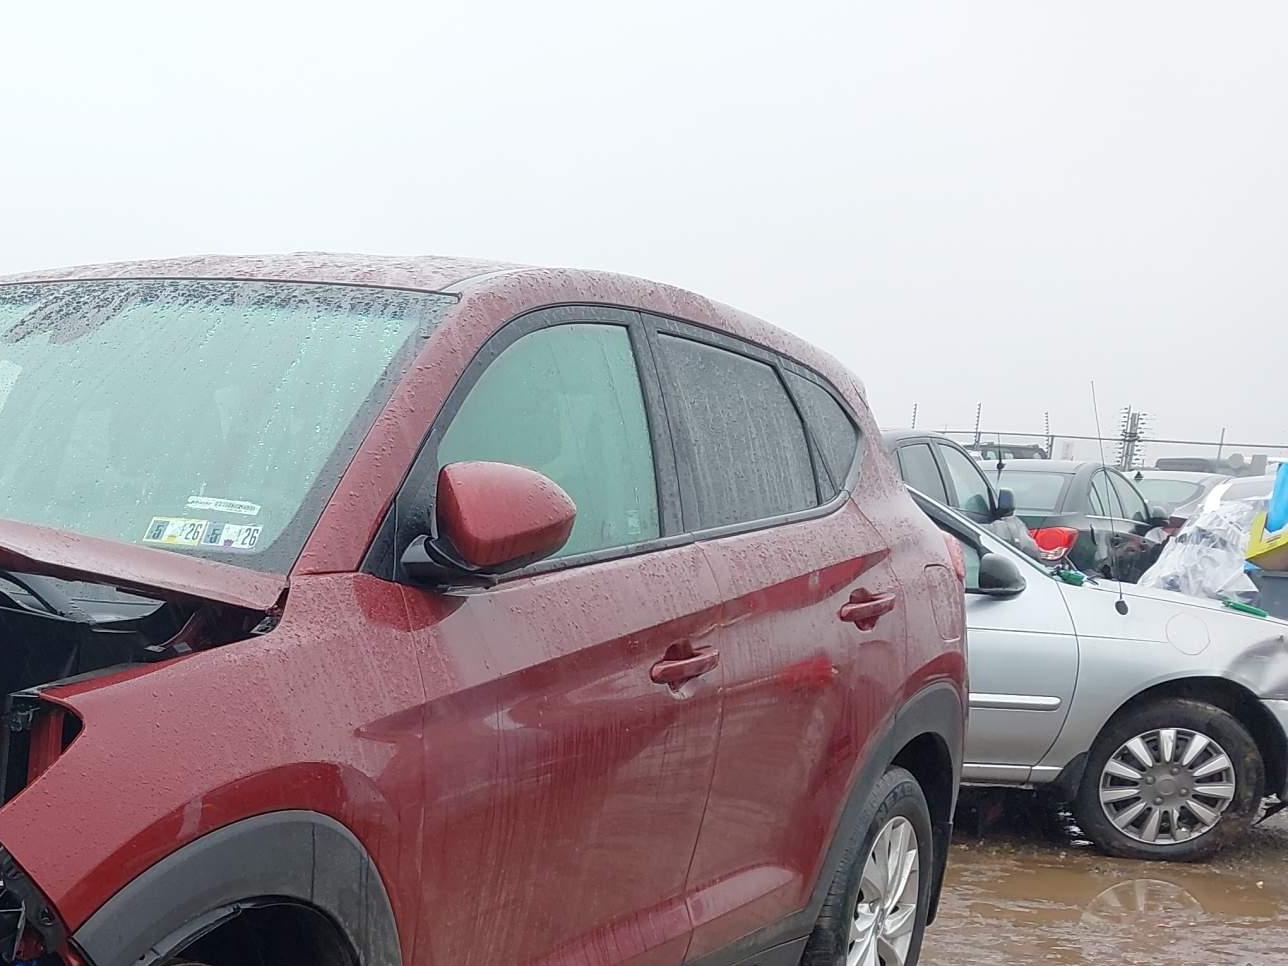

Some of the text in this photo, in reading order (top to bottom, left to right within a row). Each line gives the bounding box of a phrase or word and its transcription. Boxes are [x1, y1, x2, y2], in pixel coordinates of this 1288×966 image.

[152, 523, 203, 541] 5 26
[209, 528, 259, 546] 5 26
